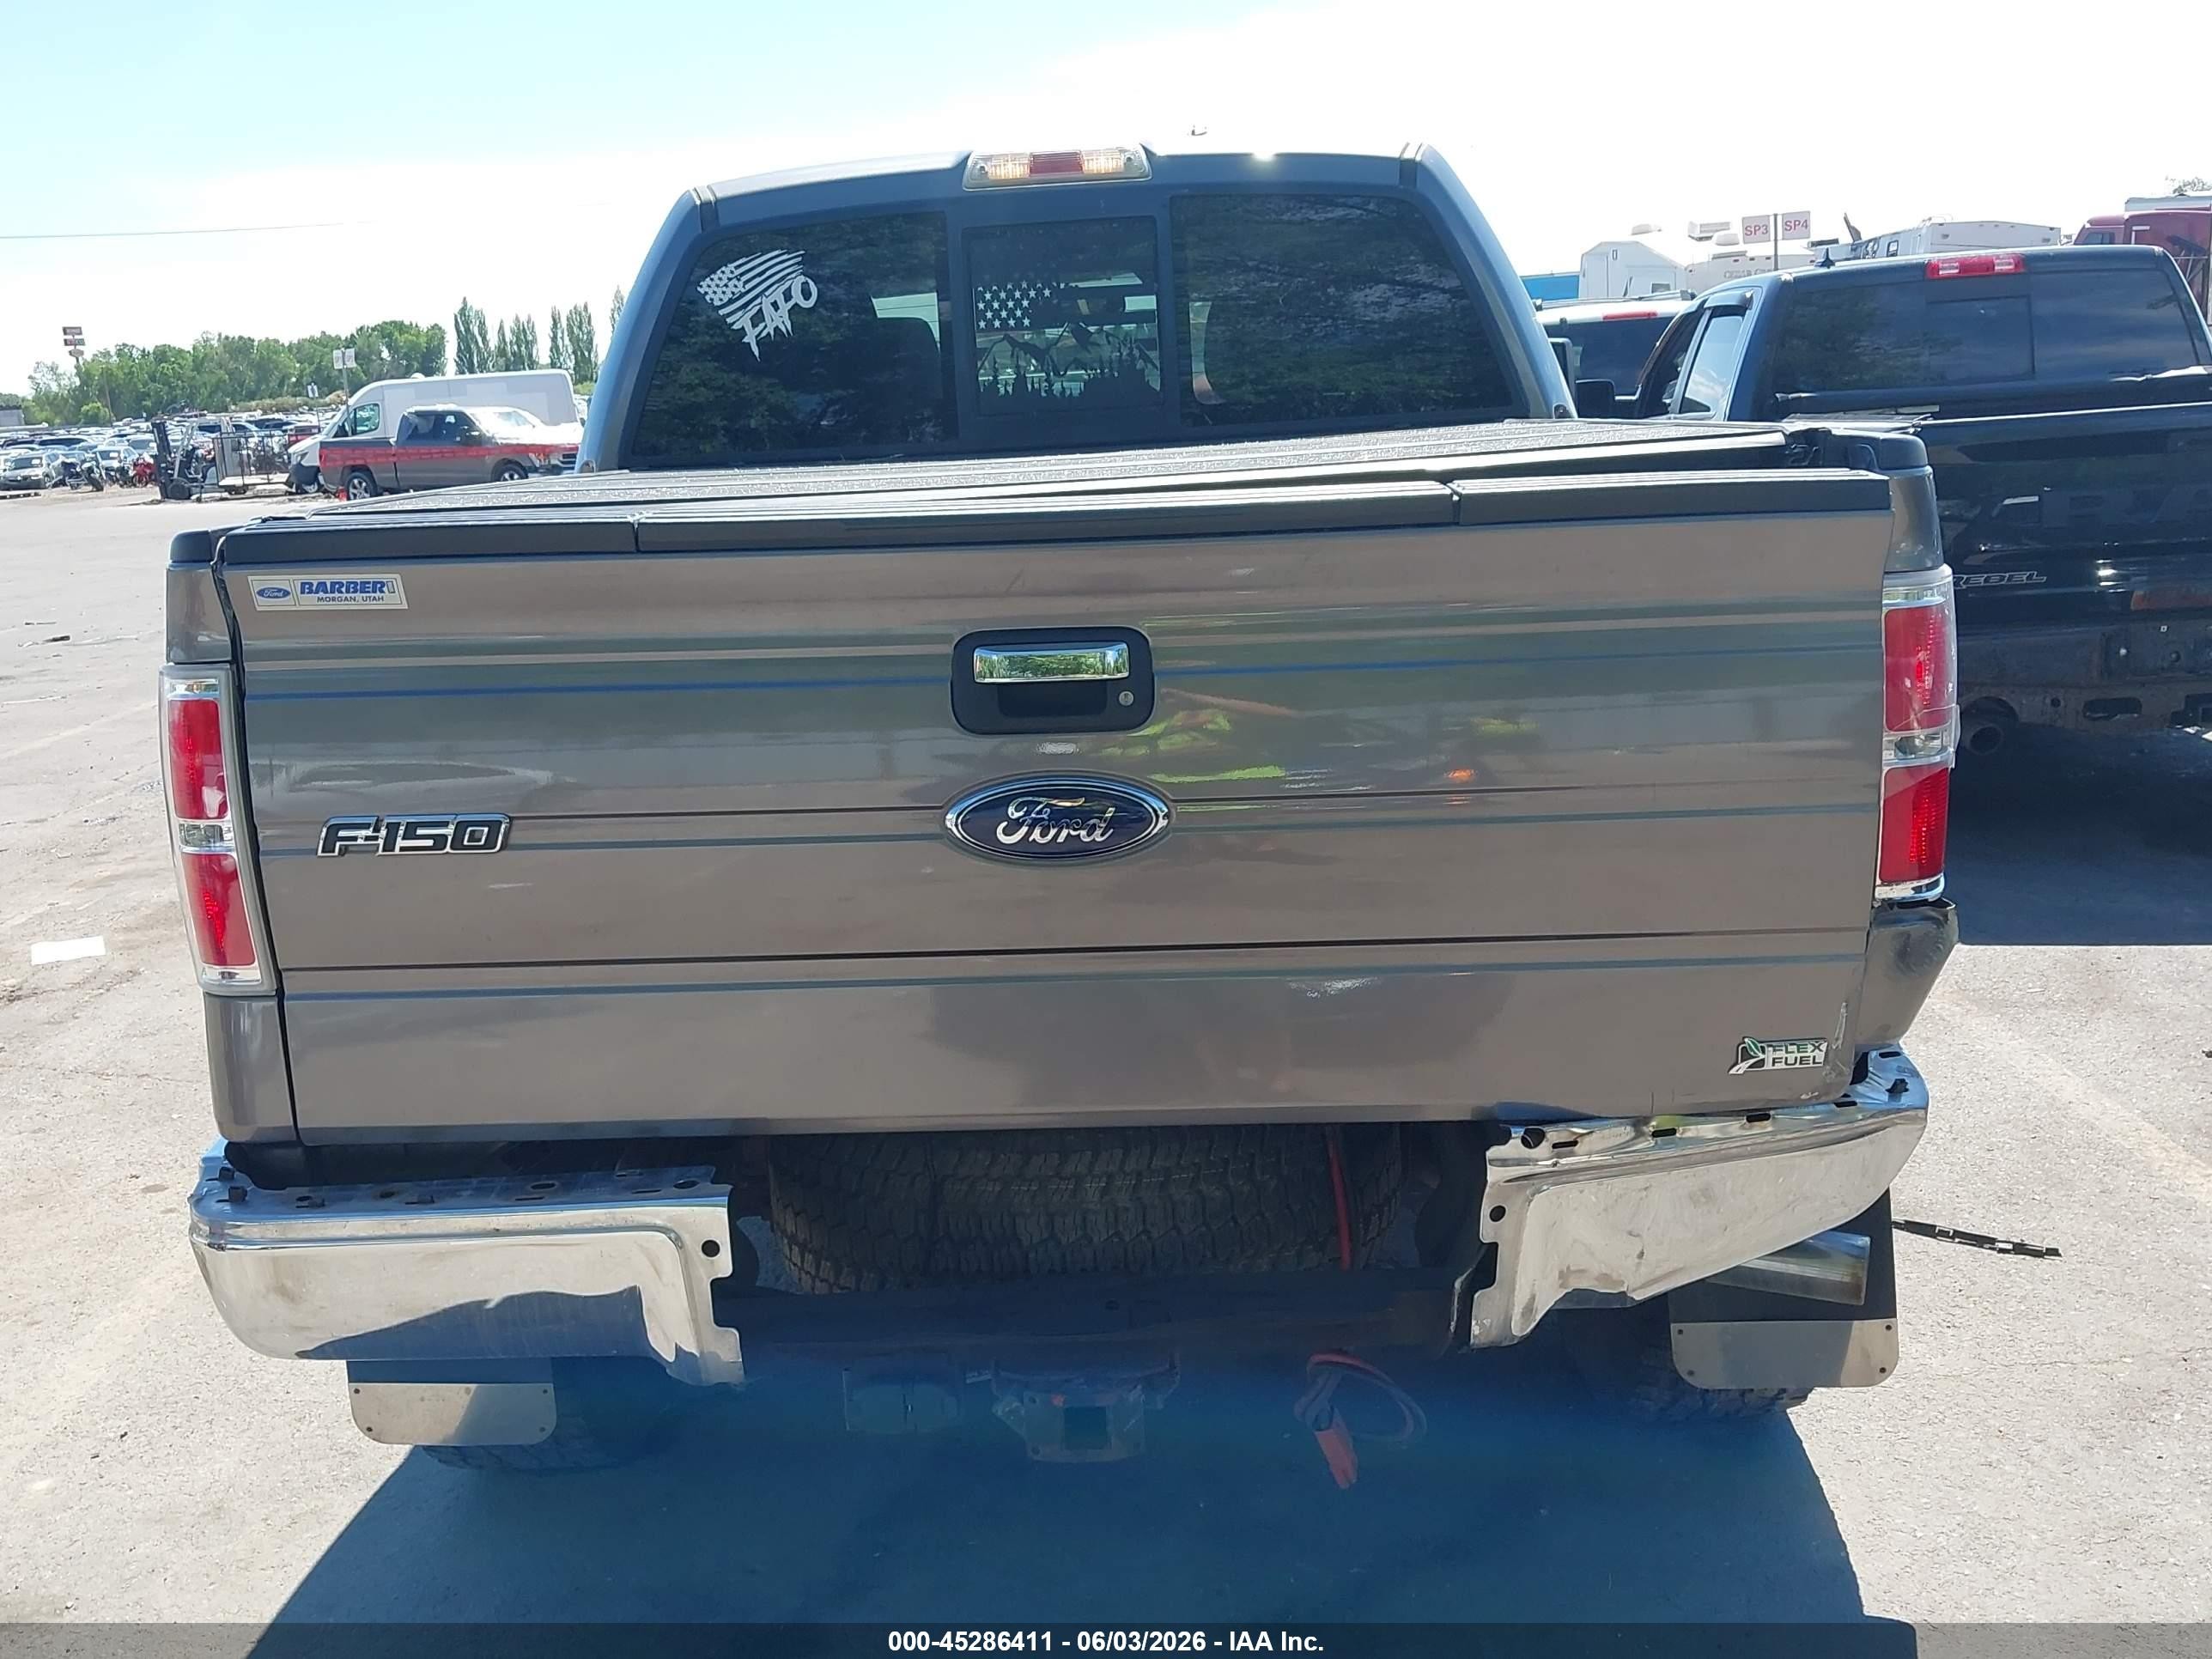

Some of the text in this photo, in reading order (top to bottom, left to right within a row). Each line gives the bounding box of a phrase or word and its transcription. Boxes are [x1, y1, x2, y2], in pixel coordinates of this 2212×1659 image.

[1744, 223, 1769, 237] SP3
[1784, 218, 1808, 232] SP4
[263, 587, 285, 599] Ford
[300, 580, 386, 595] BARBER
[316, 595, 360, 604] MORGAN,
[995, 795, 1117, 846] Ford
[317, 814, 511, 857] F-150
[1767, 1042, 1824, 1054] FLEX
[1771, 1055, 1823, 1067] FUEL
